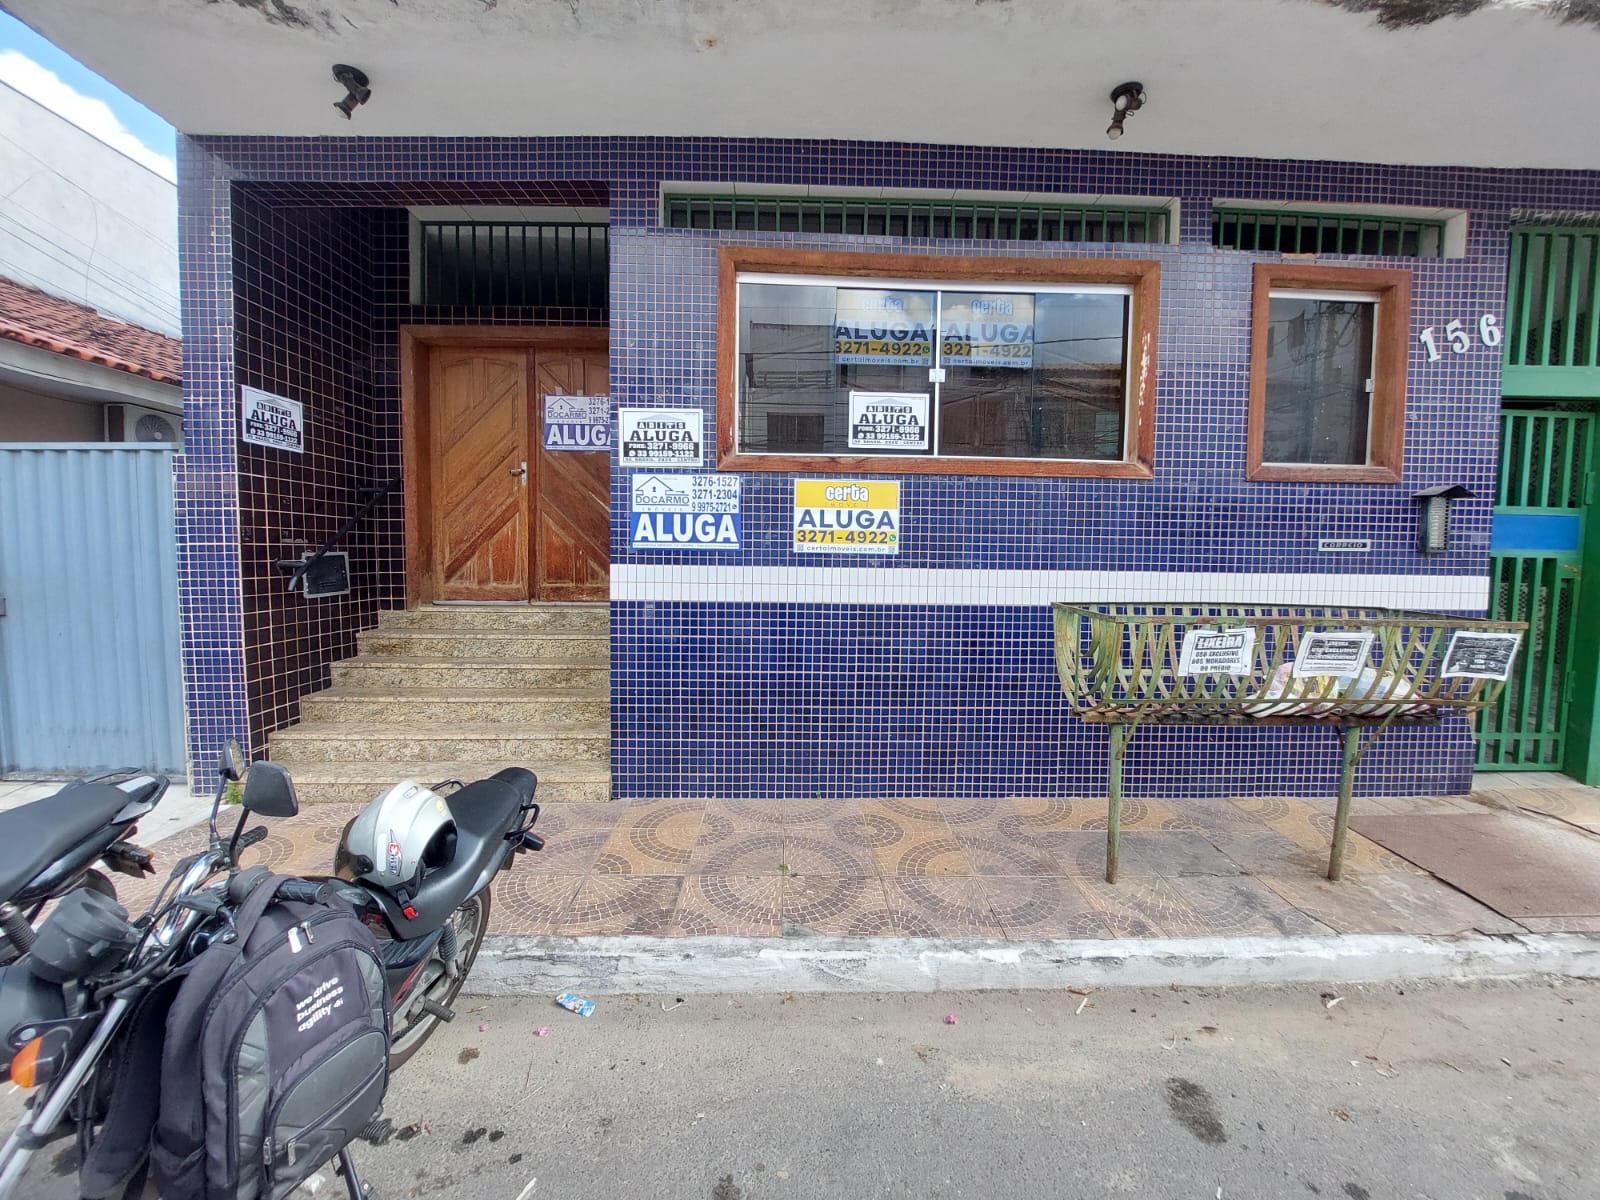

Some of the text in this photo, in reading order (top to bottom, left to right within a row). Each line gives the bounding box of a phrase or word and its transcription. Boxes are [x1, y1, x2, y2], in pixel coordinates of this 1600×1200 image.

[972, 298, 1013, 316] certa
[835, 321, 928, 341] ALUGA
[944, 322, 1033, 343] ALUGA
[1420, 314, 1500, 362] 156
[836, 341, 921, 356] 3271-4922
[944, 343, 1031, 358] 3271-4922
[251, 410, 296, 430] ALUGA
[859, 414, 919, 425] ALUGA
[630, 430, 693, 441] ALUGA
[692, 476, 738, 487] 3276-1527
[692, 489, 737, 500] 3271-2304
[826, 484, 869, 502] certa
[692, 502, 731, 512] 9 9975-2721
[634, 514, 738, 542] ALUGA
[798, 509, 895, 530] ALUGA
[798, 530, 888, 544] 3271-4922
[1197, 635, 1242, 649] LIXEIRA
[296, 977, 338, 1010] we drive
[297, 986, 343, 1022] business
[298, 1004, 332, 1032] agility
